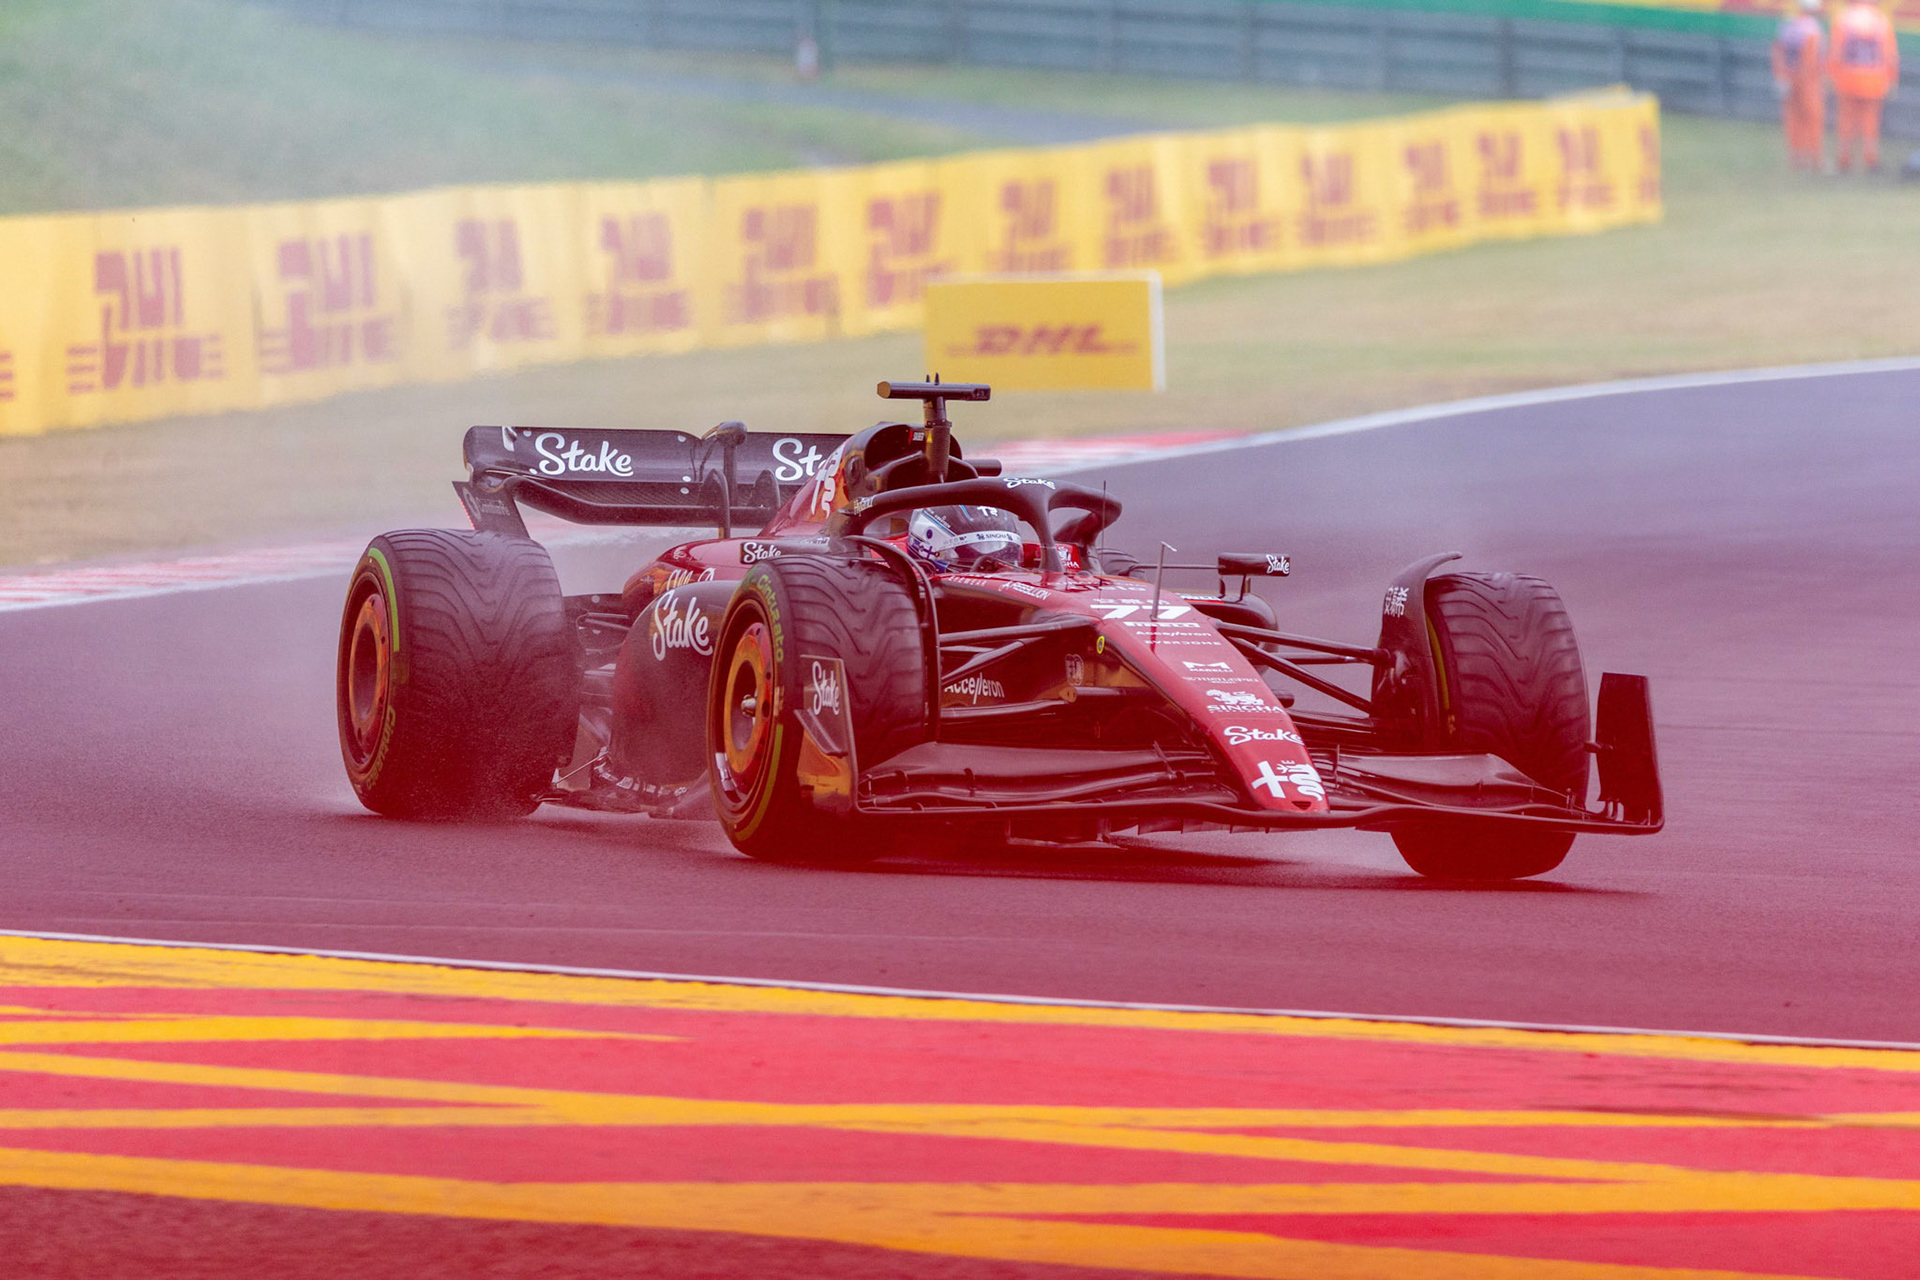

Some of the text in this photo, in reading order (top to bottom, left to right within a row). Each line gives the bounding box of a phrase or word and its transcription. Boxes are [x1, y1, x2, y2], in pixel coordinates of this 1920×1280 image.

[974, 321, 1108, 356] DHL
[534, 432, 634, 477] Stake
[1002, 477, 1056, 490] Stake
[742, 542, 782, 563] Stake
[1266, 554, 1290, 575] Stake
[757, 574, 785, 663] Cinturato
[1089, 604, 1192, 620] 77
[652, 589, 714, 662] Stake
[812, 661, 840, 716] Stake
[1206, 704, 1287, 715] SINGHA
[1223, 725, 1306, 746] Stake
